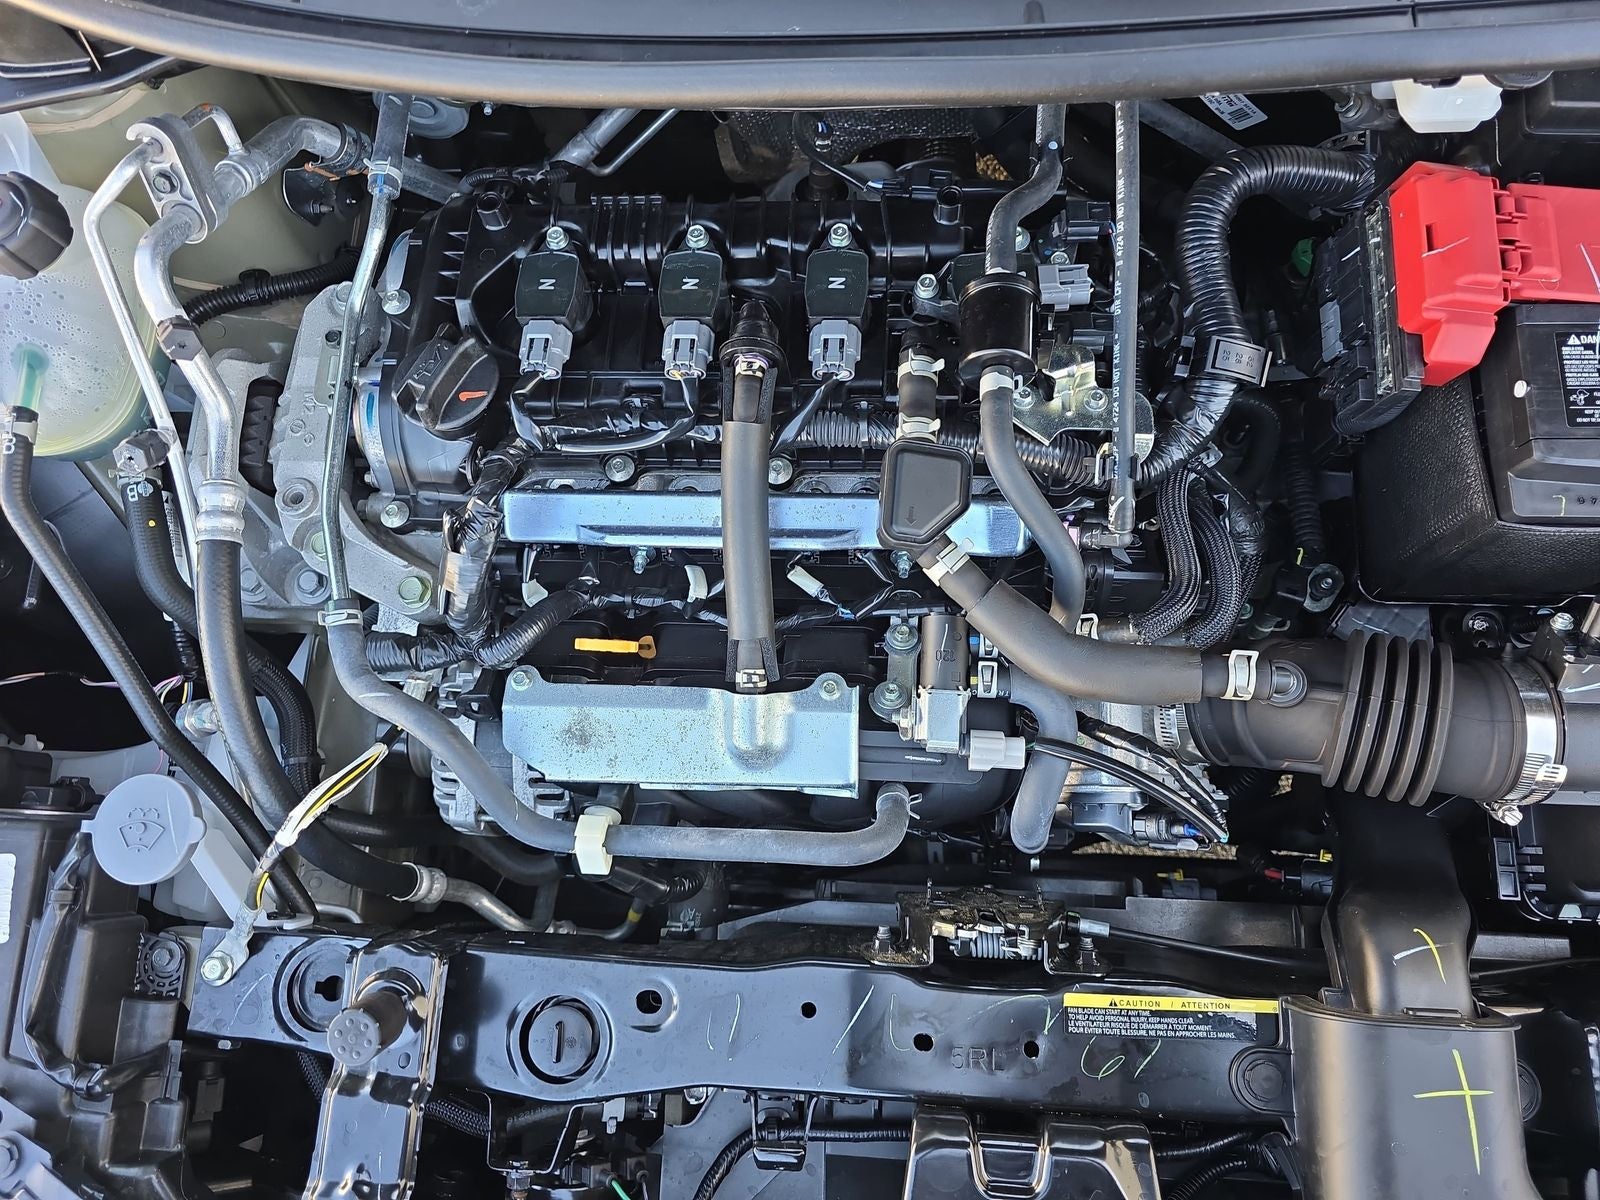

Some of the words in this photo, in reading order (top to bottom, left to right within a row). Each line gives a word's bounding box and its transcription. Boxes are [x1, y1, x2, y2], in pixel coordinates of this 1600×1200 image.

[1117, 176, 1125, 200] KINK
[1116, 202, 1124, 220] NOT
[1580, 335, 1600, 344] DAN
[1113, 342, 1121, 364] KINK
[1112, 367, 1120, 384] NOT
[1112, 386, 1120, 398] DO
[1112, 401, 1120, 423] 4724
[1119, 999, 1161, 1008] CAUTION
[1181, 1001, 1231, 1010] ATTENTION
[951, 1046, 1004, 1071] 5RL
